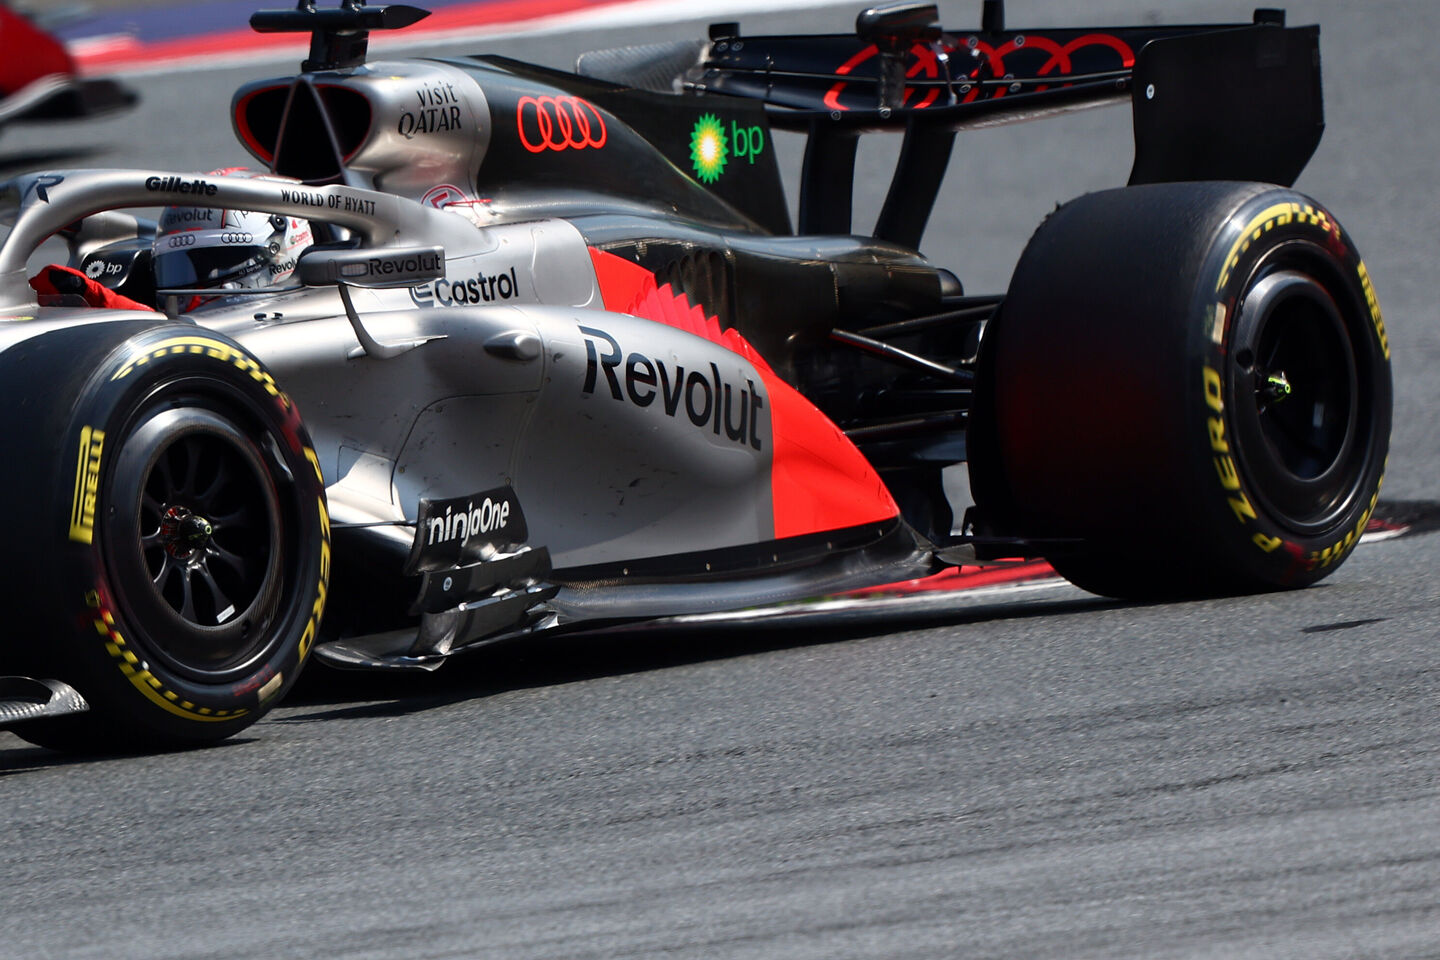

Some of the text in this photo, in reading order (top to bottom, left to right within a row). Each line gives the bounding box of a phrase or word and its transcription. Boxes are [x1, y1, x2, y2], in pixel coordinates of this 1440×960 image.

[416, 80, 459, 107] visit
[398, 105, 462, 140] QATAR
[731, 119, 765, 165] bp
[145, 175, 219, 196] Gillette
[281, 188, 376, 217] WORLD OF HYATT
[106, 261, 123, 275] bp
[269, 257, 298, 276] Revol
[369, 253, 442, 276] Revolut
[435, 266, 520, 309] Castrol
[578, 324, 763, 452] Revolut
[1203, 365, 1258, 525] ZERO
[69, 424, 106, 545] PIRELLI
[428, 497, 510, 548] ninjaOne
[298, 495, 331, 665] ZERO
